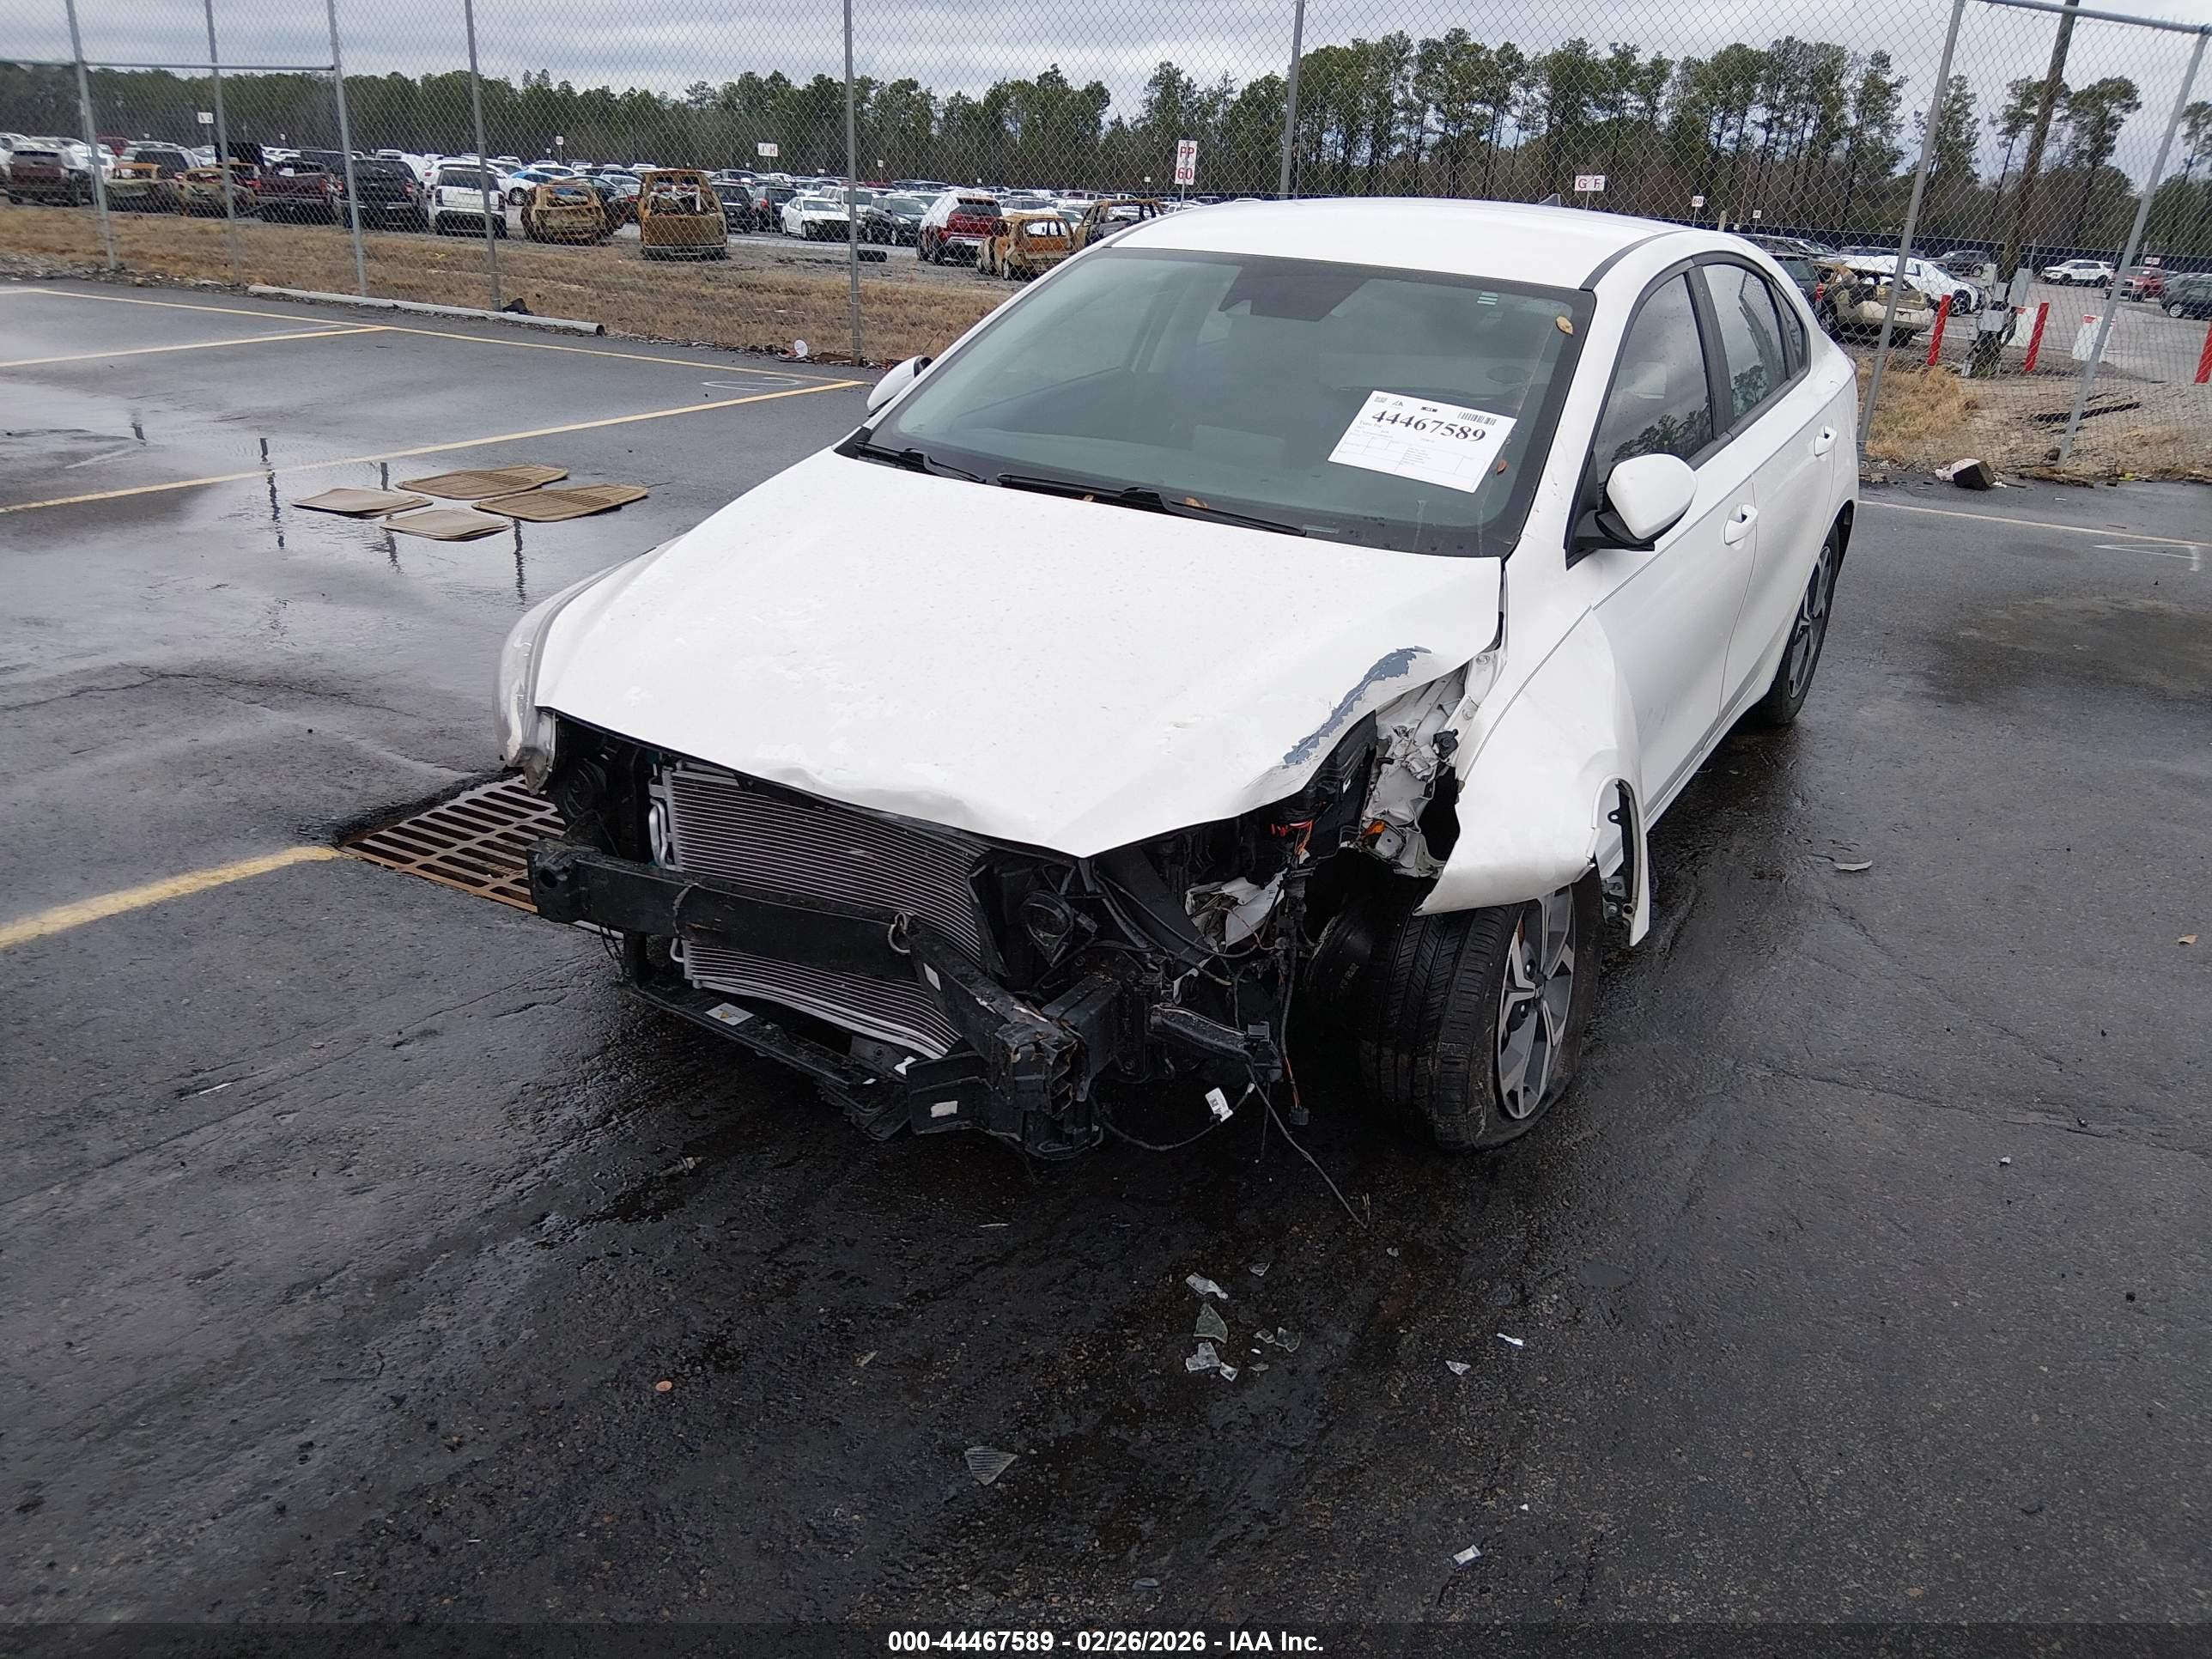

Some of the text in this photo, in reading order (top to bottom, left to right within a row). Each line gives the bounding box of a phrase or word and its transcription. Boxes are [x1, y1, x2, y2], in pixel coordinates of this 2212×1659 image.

[769, 146, 776, 155] H
[1180, 147, 1194, 158] PP
[1178, 167, 1193, 179] 60
[1577, 178, 1601, 189] G F
[1371, 410, 1486, 442] 44467589
